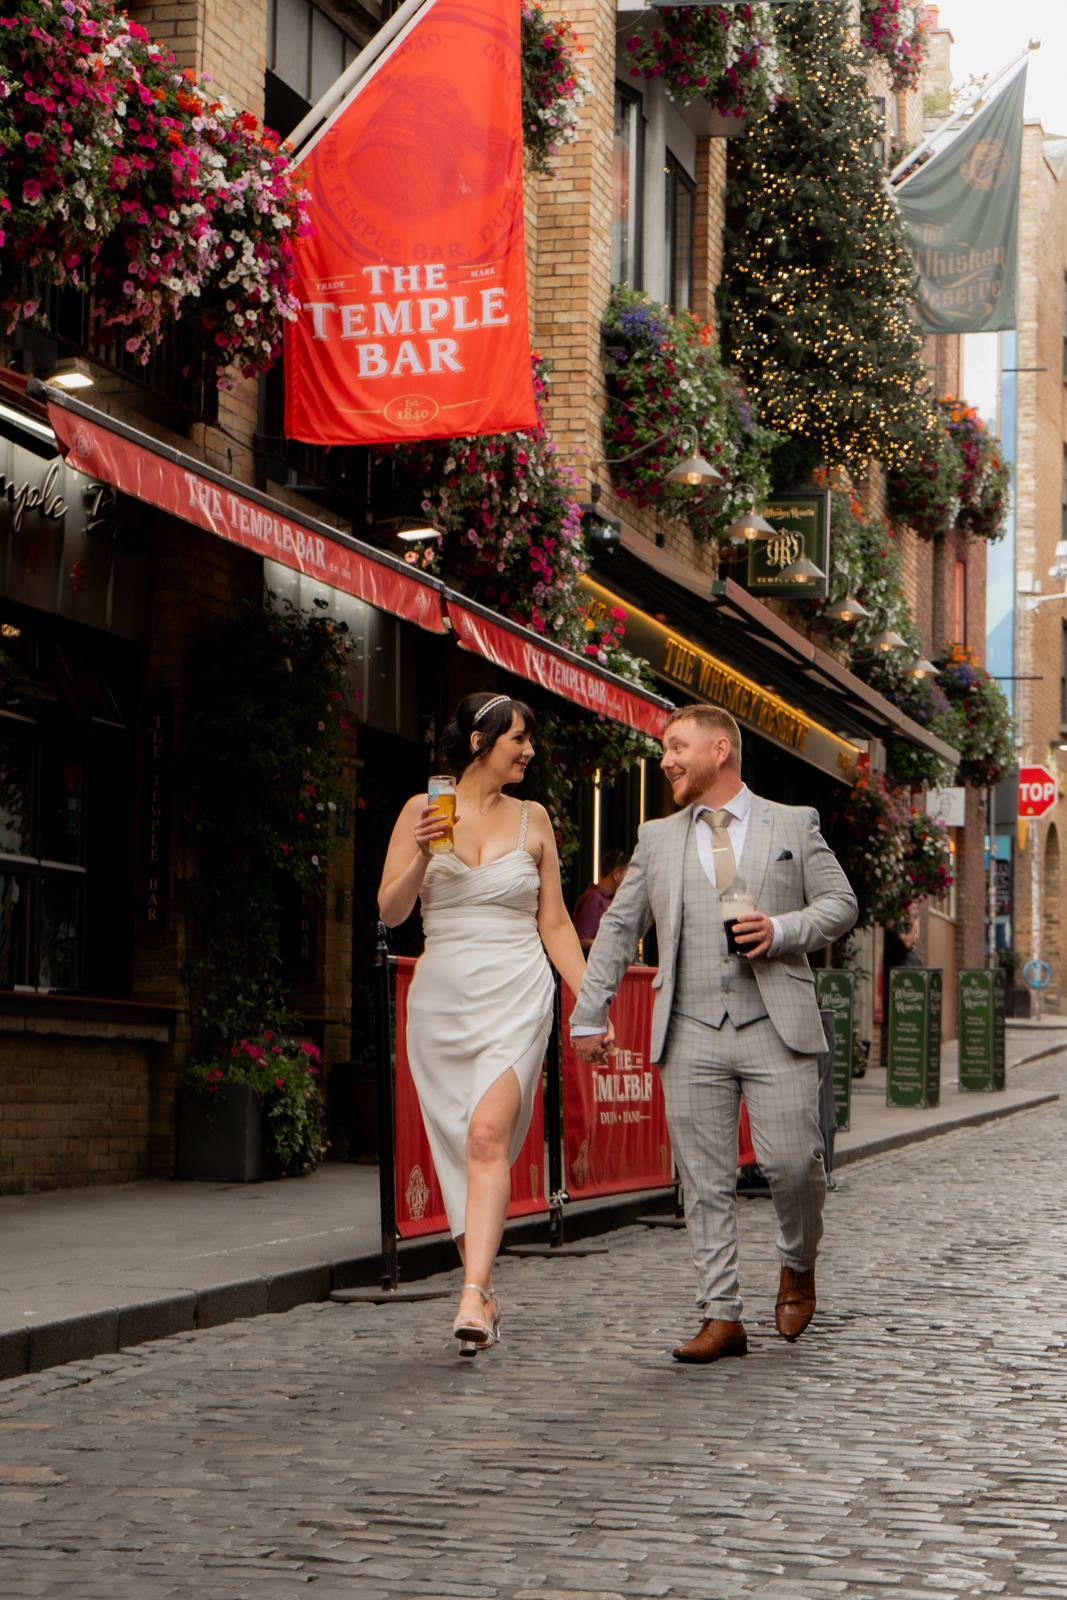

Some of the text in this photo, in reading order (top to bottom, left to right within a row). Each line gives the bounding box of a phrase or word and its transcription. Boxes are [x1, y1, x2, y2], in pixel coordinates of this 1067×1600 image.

[315, 280, 346, 292] TRADE
[362, 263, 448, 295] THE
[470, 267, 496, 278] MARK
[303, 287, 510, 341] TEMPLE
[355, 338, 464, 380] BAR
[395, 406, 430, 421] 1840
[184, 472, 222, 520] THE
[227, 494, 294, 553] TEMPLE
[295, 529, 327, 570] BAR
[548, 655, 587, 695] TEMPLE
[587, 677, 606, 705] BAR
[664, 637, 810, 753] THE WHISKEY RESERVE
[1018, 782, 1056, 802] TOP
